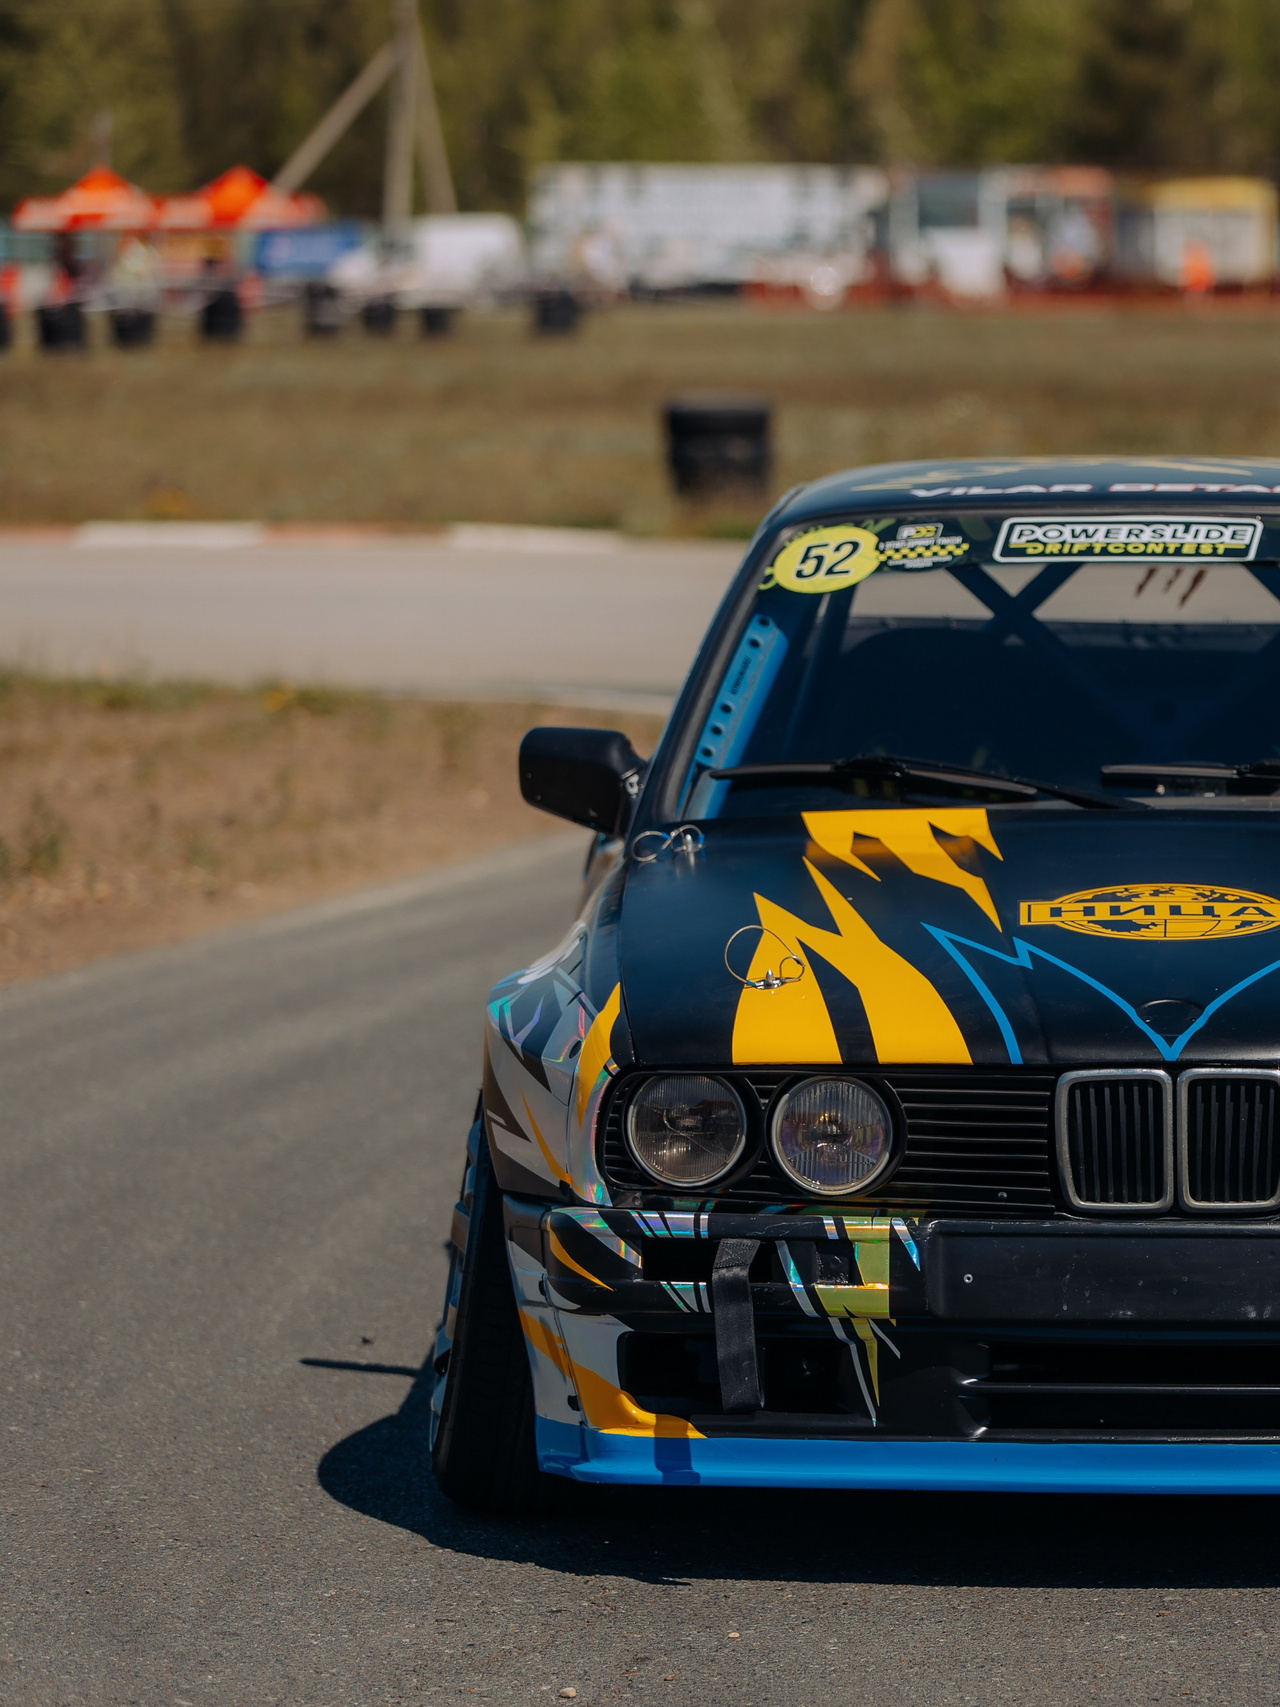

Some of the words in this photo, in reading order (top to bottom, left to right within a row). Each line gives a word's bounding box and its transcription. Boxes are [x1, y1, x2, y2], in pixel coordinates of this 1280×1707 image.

[909, 483, 1093, 498] VILAR
[1012, 525, 1249, 543] POWERSLIDE
[1024, 543, 1228, 555] DRIFTCONTEST
[795, 540, 861, 579] 52
[1049, 904, 1277, 918] НИЦА
